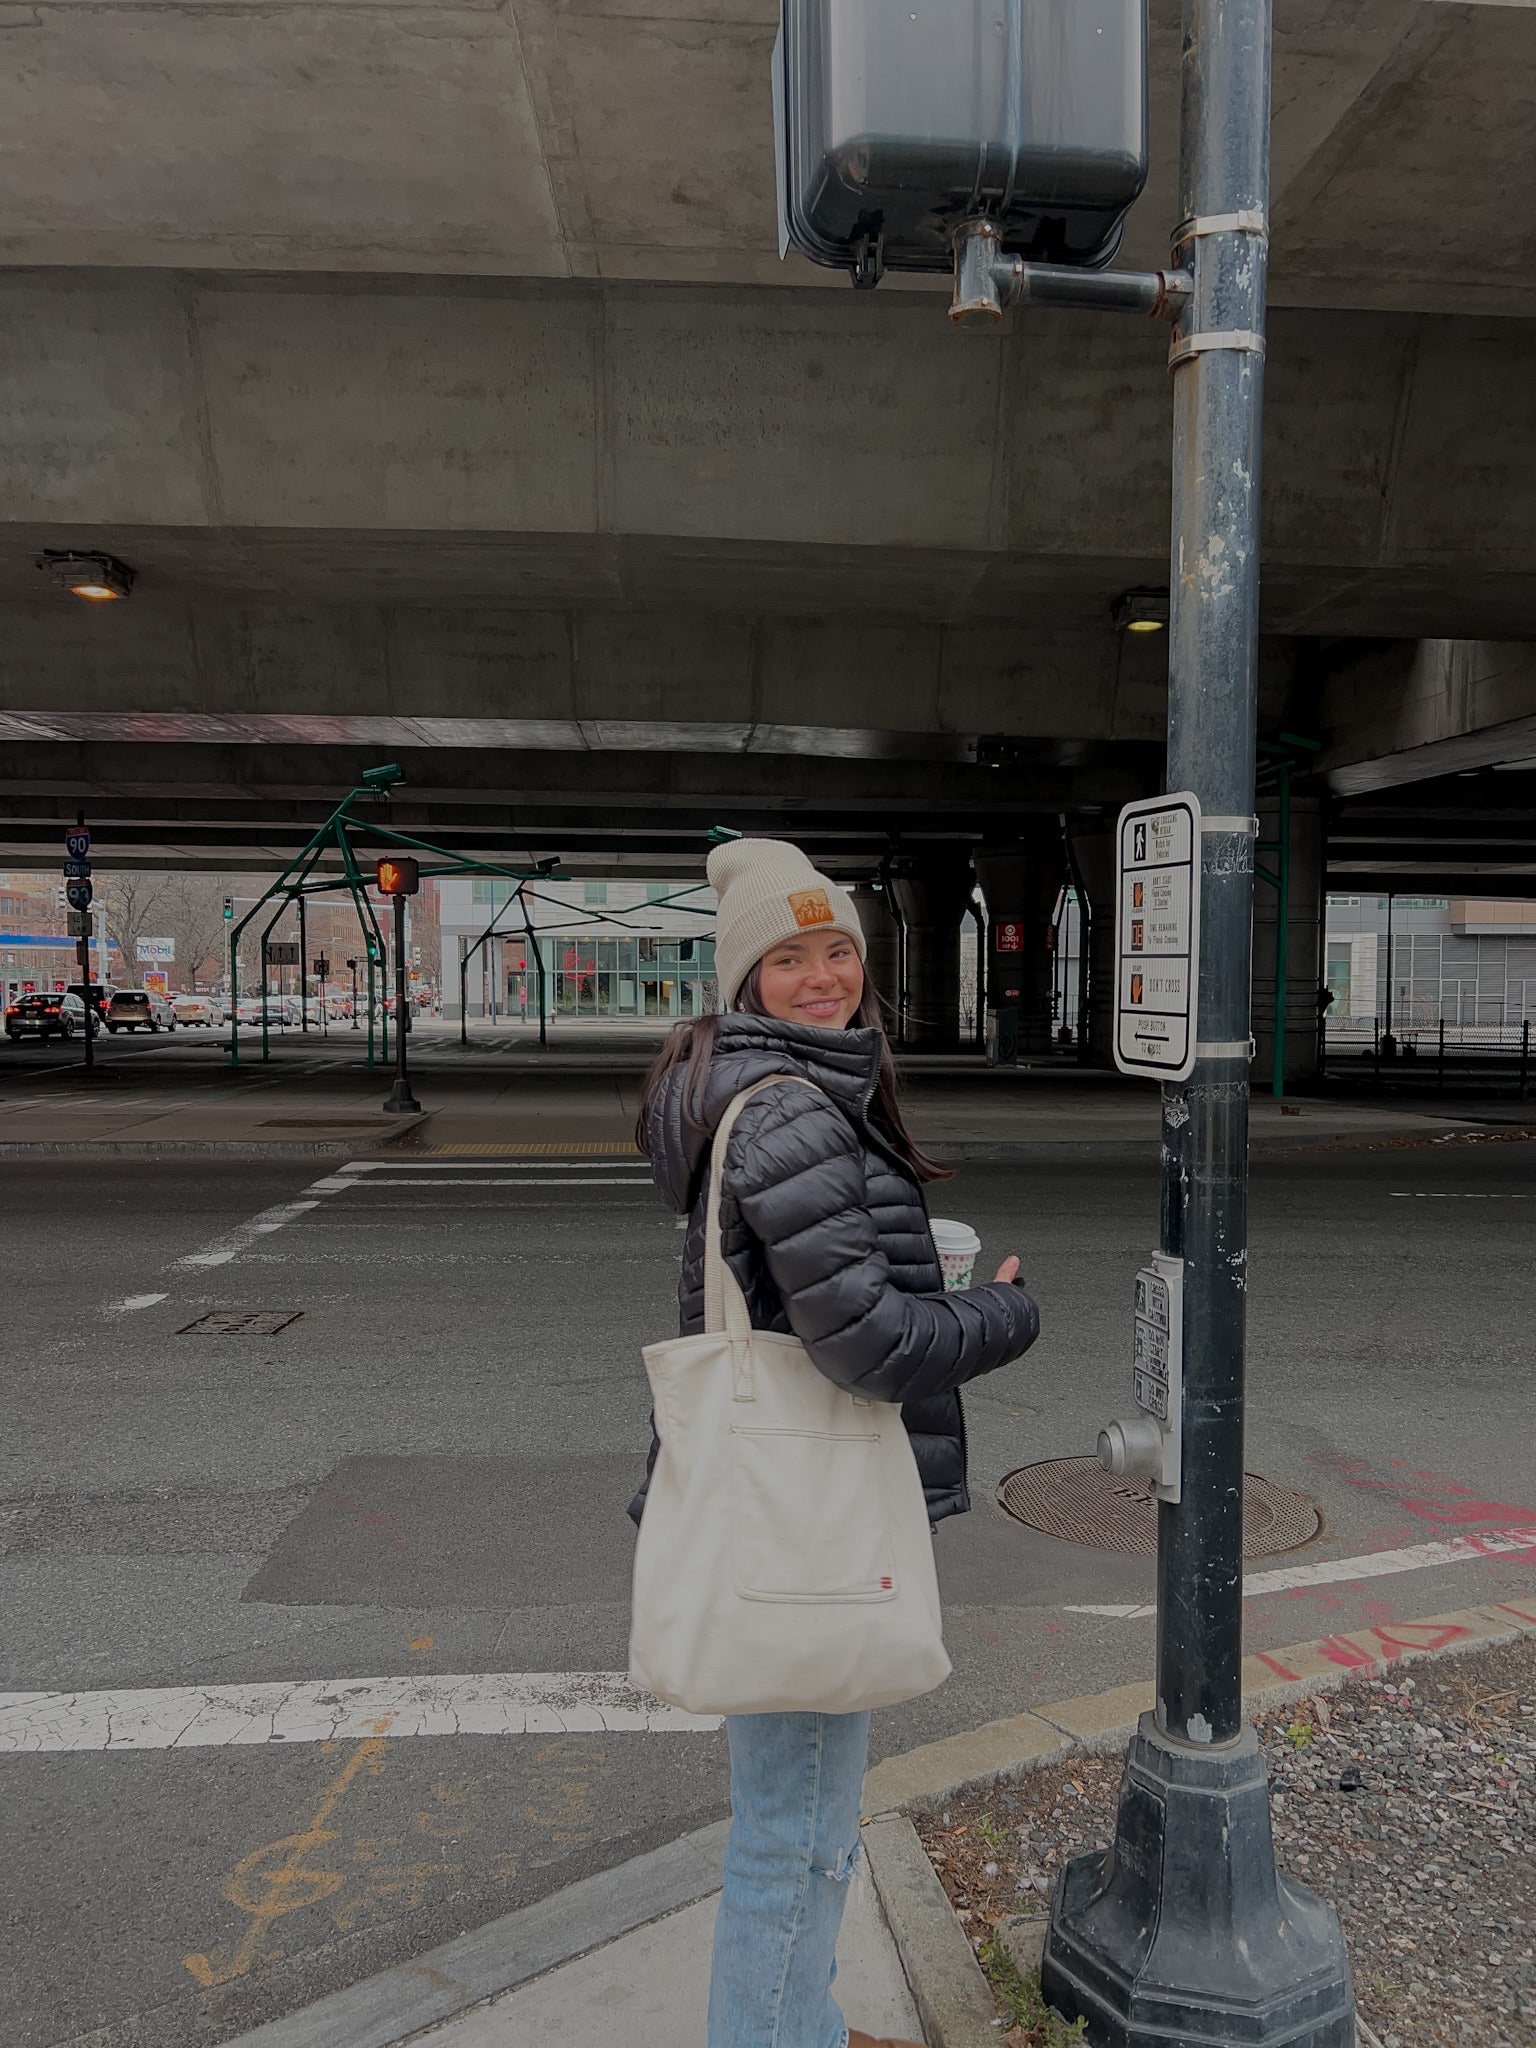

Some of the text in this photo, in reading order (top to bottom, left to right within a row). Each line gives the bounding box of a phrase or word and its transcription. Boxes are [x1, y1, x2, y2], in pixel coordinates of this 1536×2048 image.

[69, 837, 87, 854] 90
[66, 864, 90, 876] SOUTH
[69, 887, 90, 904] 93
[1158, 922, 1178, 932] REMAINING
[1001, 935, 1019, 943] 1001
[140, 944, 171, 956] Mobil
[1149, 979, 1180, 993] DON'T CROSS
[1138, 1019, 1166, 1032] PUSH BUTTON
[1141, 1042, 1147, 1054] TO
